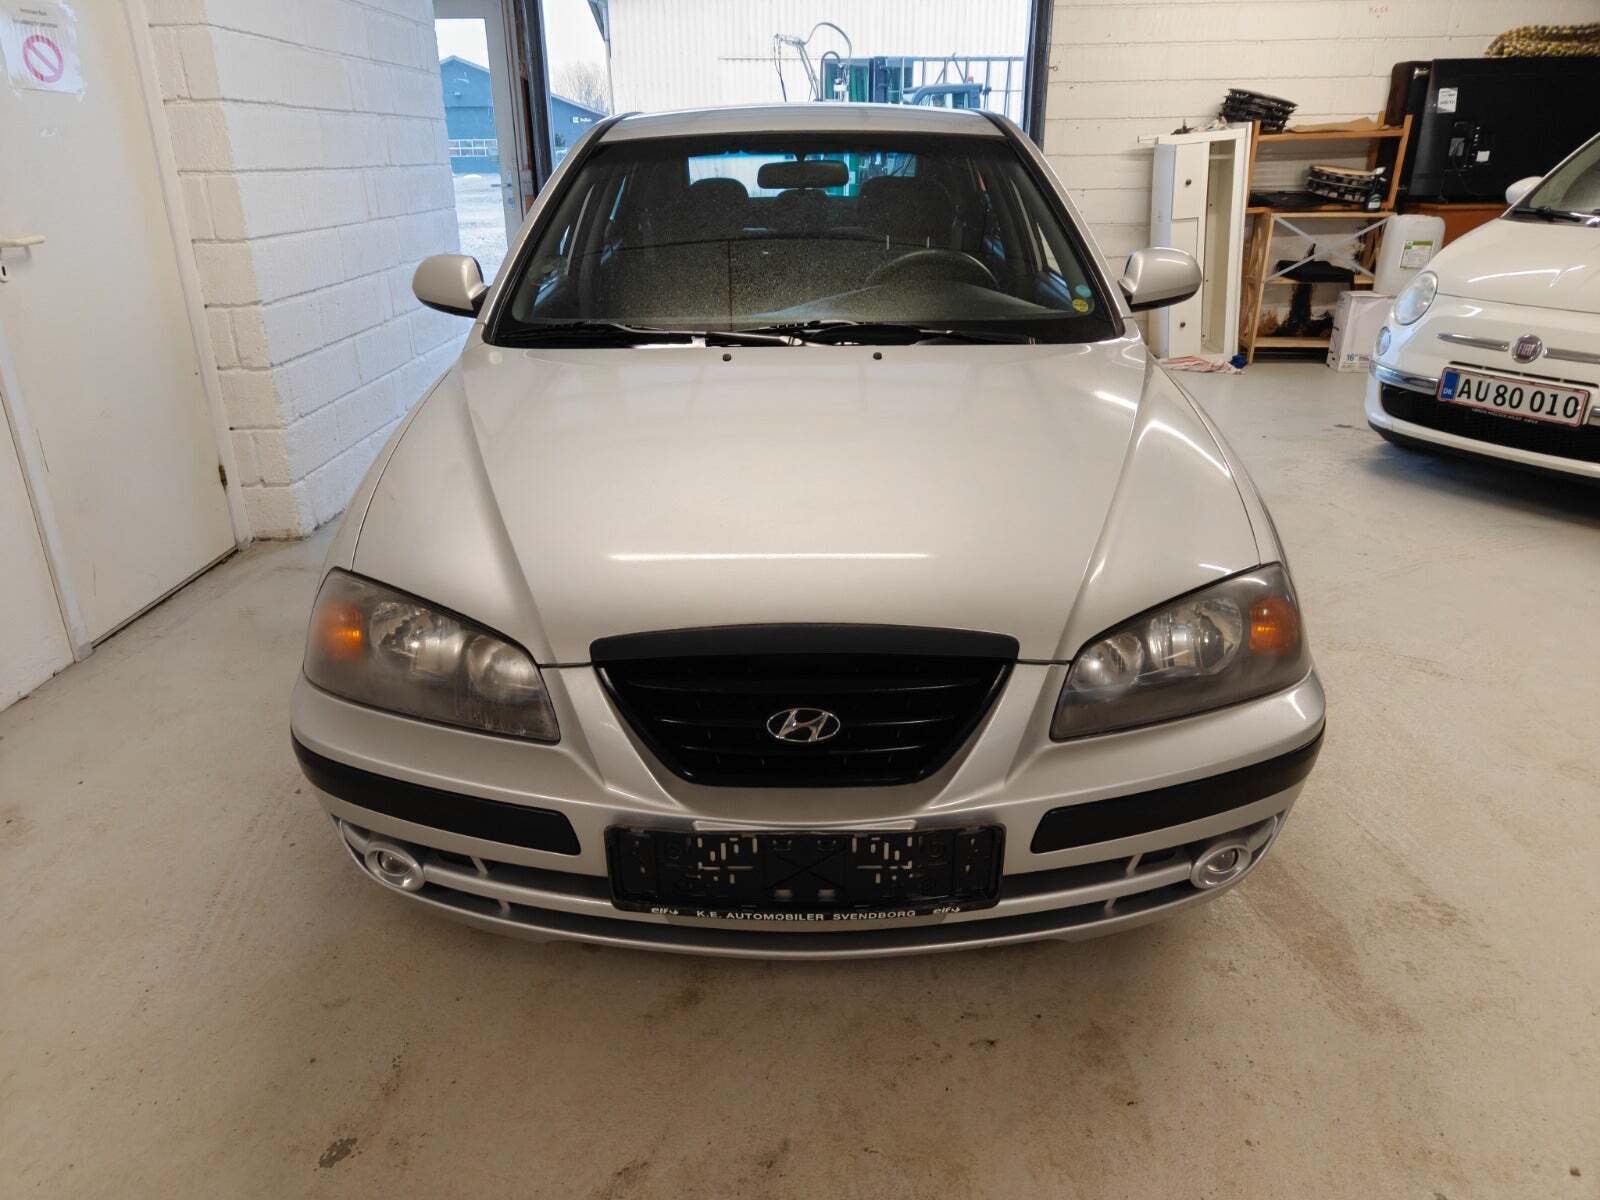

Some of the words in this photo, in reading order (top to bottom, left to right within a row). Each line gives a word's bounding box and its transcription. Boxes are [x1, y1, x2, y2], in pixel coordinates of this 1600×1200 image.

[1457, 378, 1490, 402] AU
[1493, 384, 1524, 409] 80
[1529, 390, 1579, 418] 010
[726, 912, 824, 921] AUTOMOBILER
[833, 910, 916, 920] SVENDBORG
